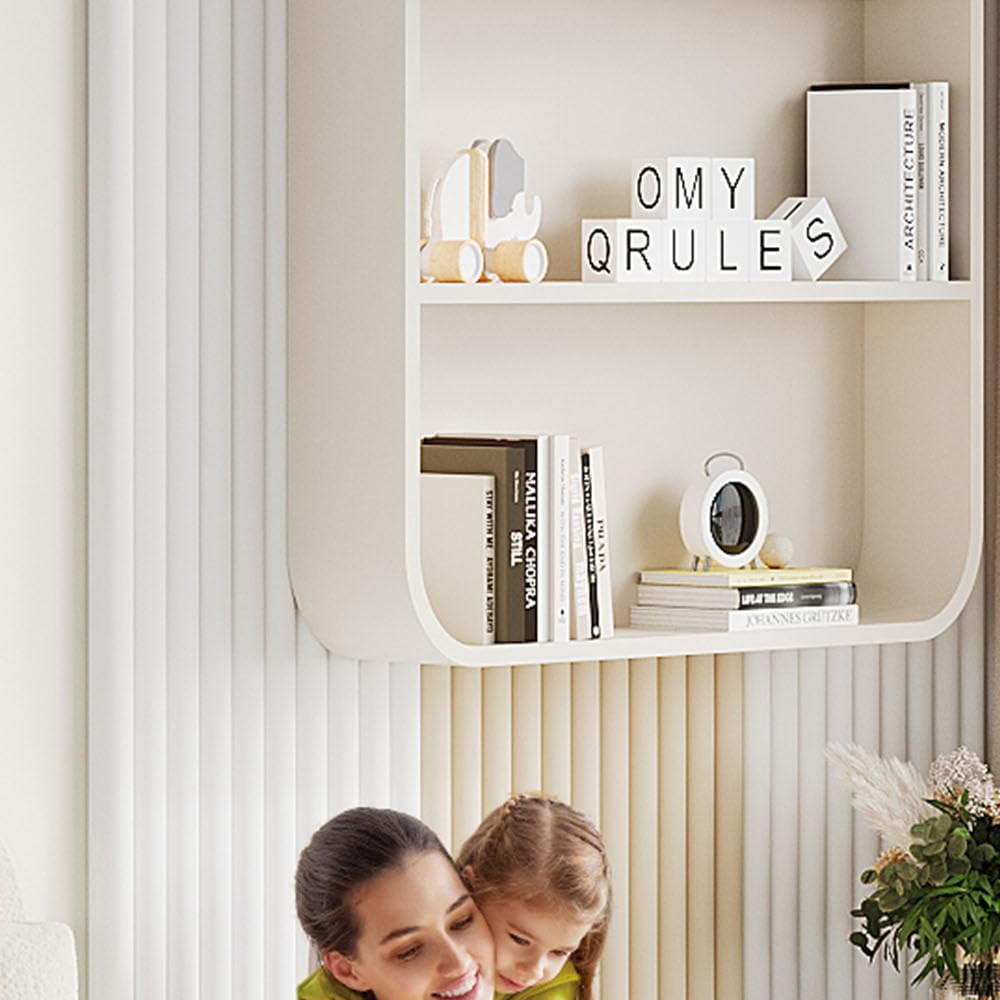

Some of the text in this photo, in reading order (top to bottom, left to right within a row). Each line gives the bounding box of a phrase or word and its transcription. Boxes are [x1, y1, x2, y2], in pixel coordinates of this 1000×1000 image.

[903, 108, 915, 250] ARCHITECTURE
[510, 532, 523, 567] STILL
[525, 547, 536, 609] CHOPRA
